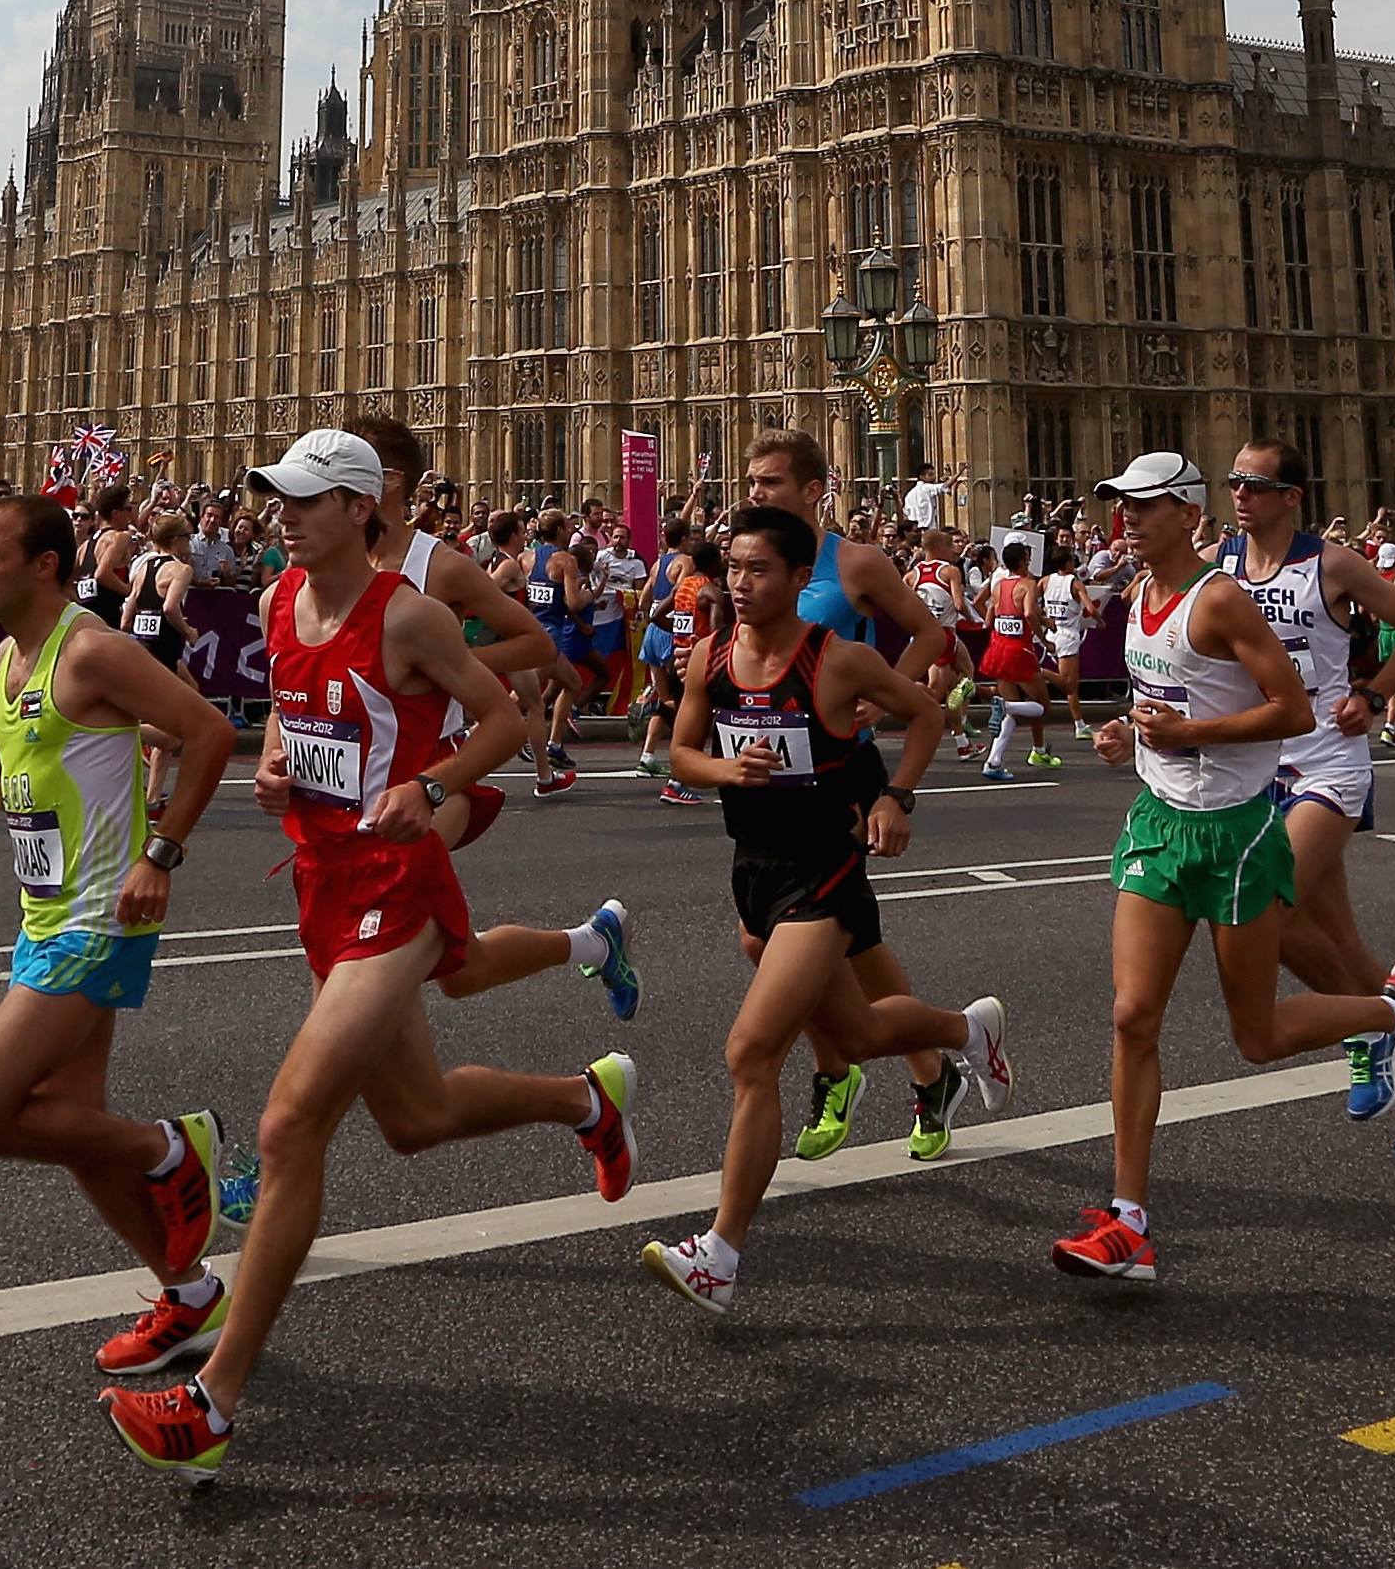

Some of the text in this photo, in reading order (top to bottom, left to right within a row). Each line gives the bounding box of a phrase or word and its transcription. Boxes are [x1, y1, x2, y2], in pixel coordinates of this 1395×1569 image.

[1247, 588, 1295, 606] ECH
[997, 620, 1021, 632] 1089
[1260, 605, 1314, 629] BLIC
[283, 715, 334, 735] London 2012
[730, 714, 782, 725] London 2012
